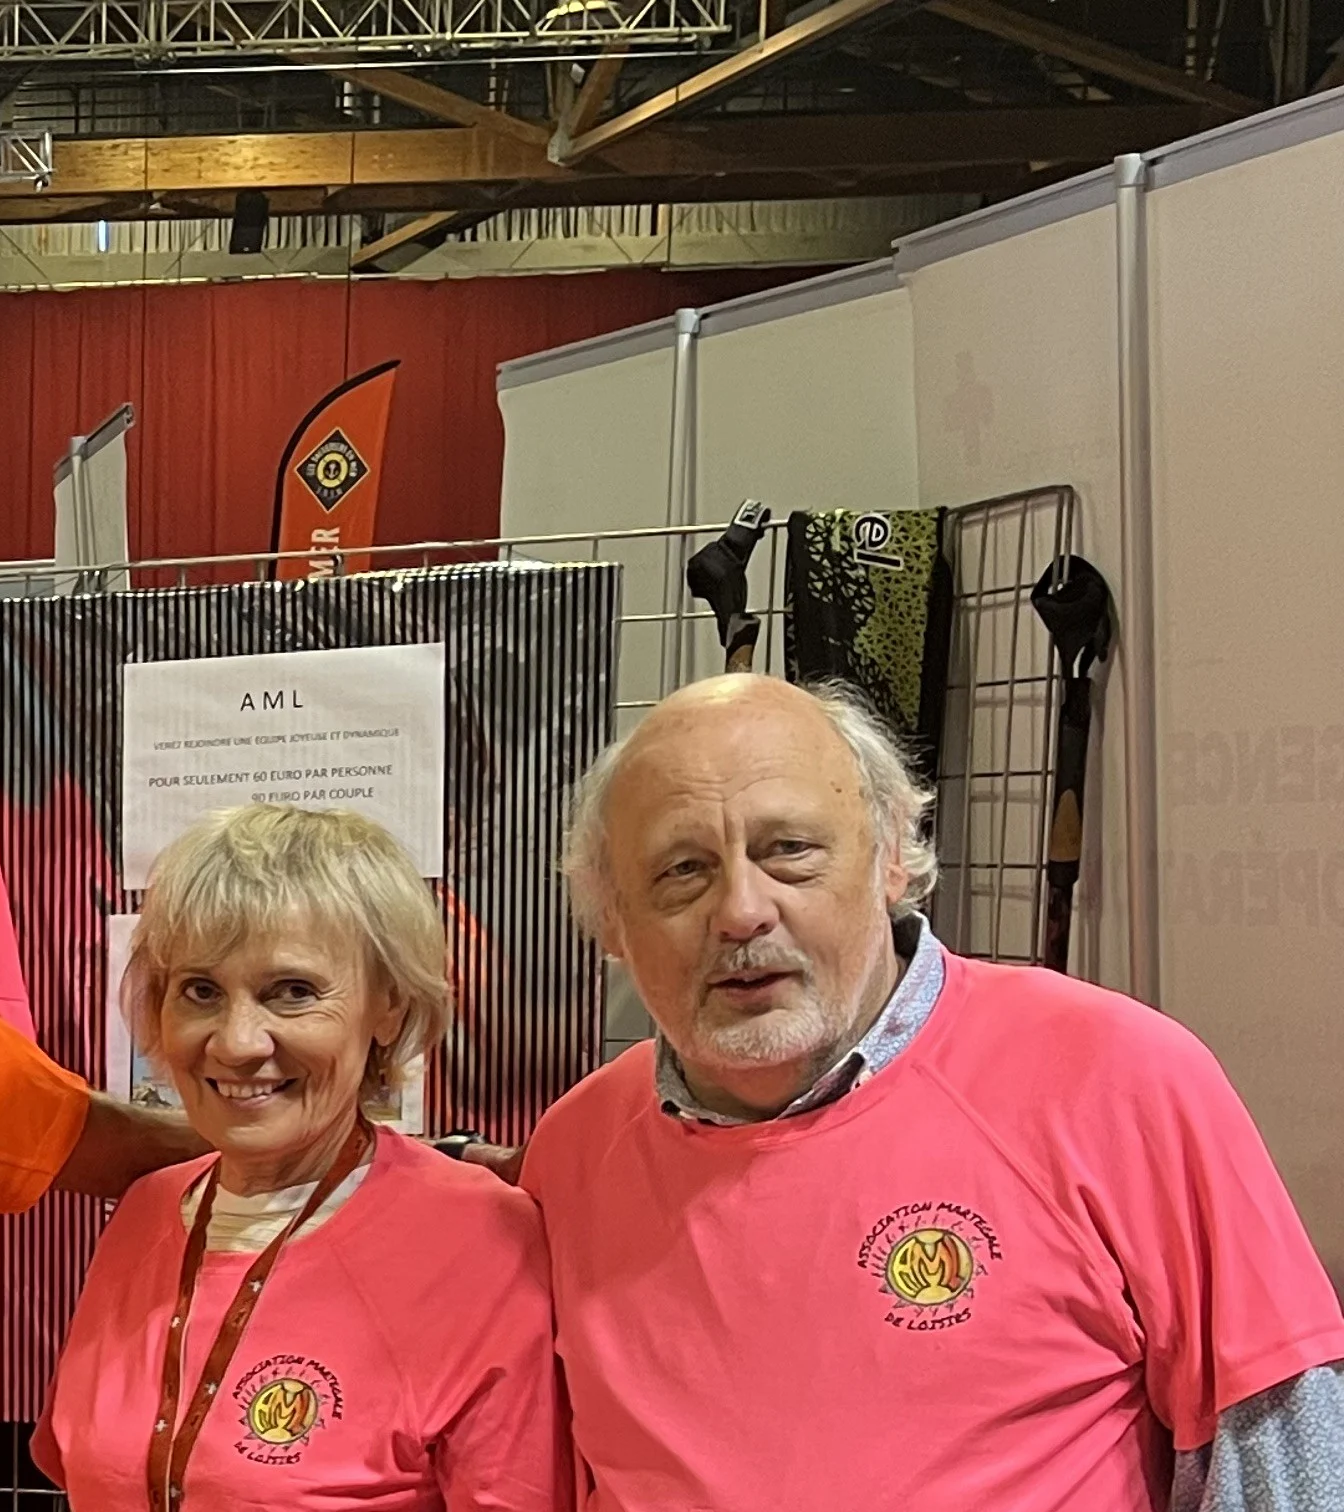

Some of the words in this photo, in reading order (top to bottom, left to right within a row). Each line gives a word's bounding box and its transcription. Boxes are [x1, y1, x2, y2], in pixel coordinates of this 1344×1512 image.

[149, 776, 181, 788] POUR
[183, 772, 250, 786] SEULEMENT
[253, 770, 268, 782] 60
[270, 769, 303, 782] EURO
[305, 767, 329, 779] PAR
[331, 764, 393, 778] PERSONNE
[303, 789, 326, 801] PAR
[329, 787, 375, 800] COUPLE
[857, 1201, 932, 1269] ASSOCIATION
